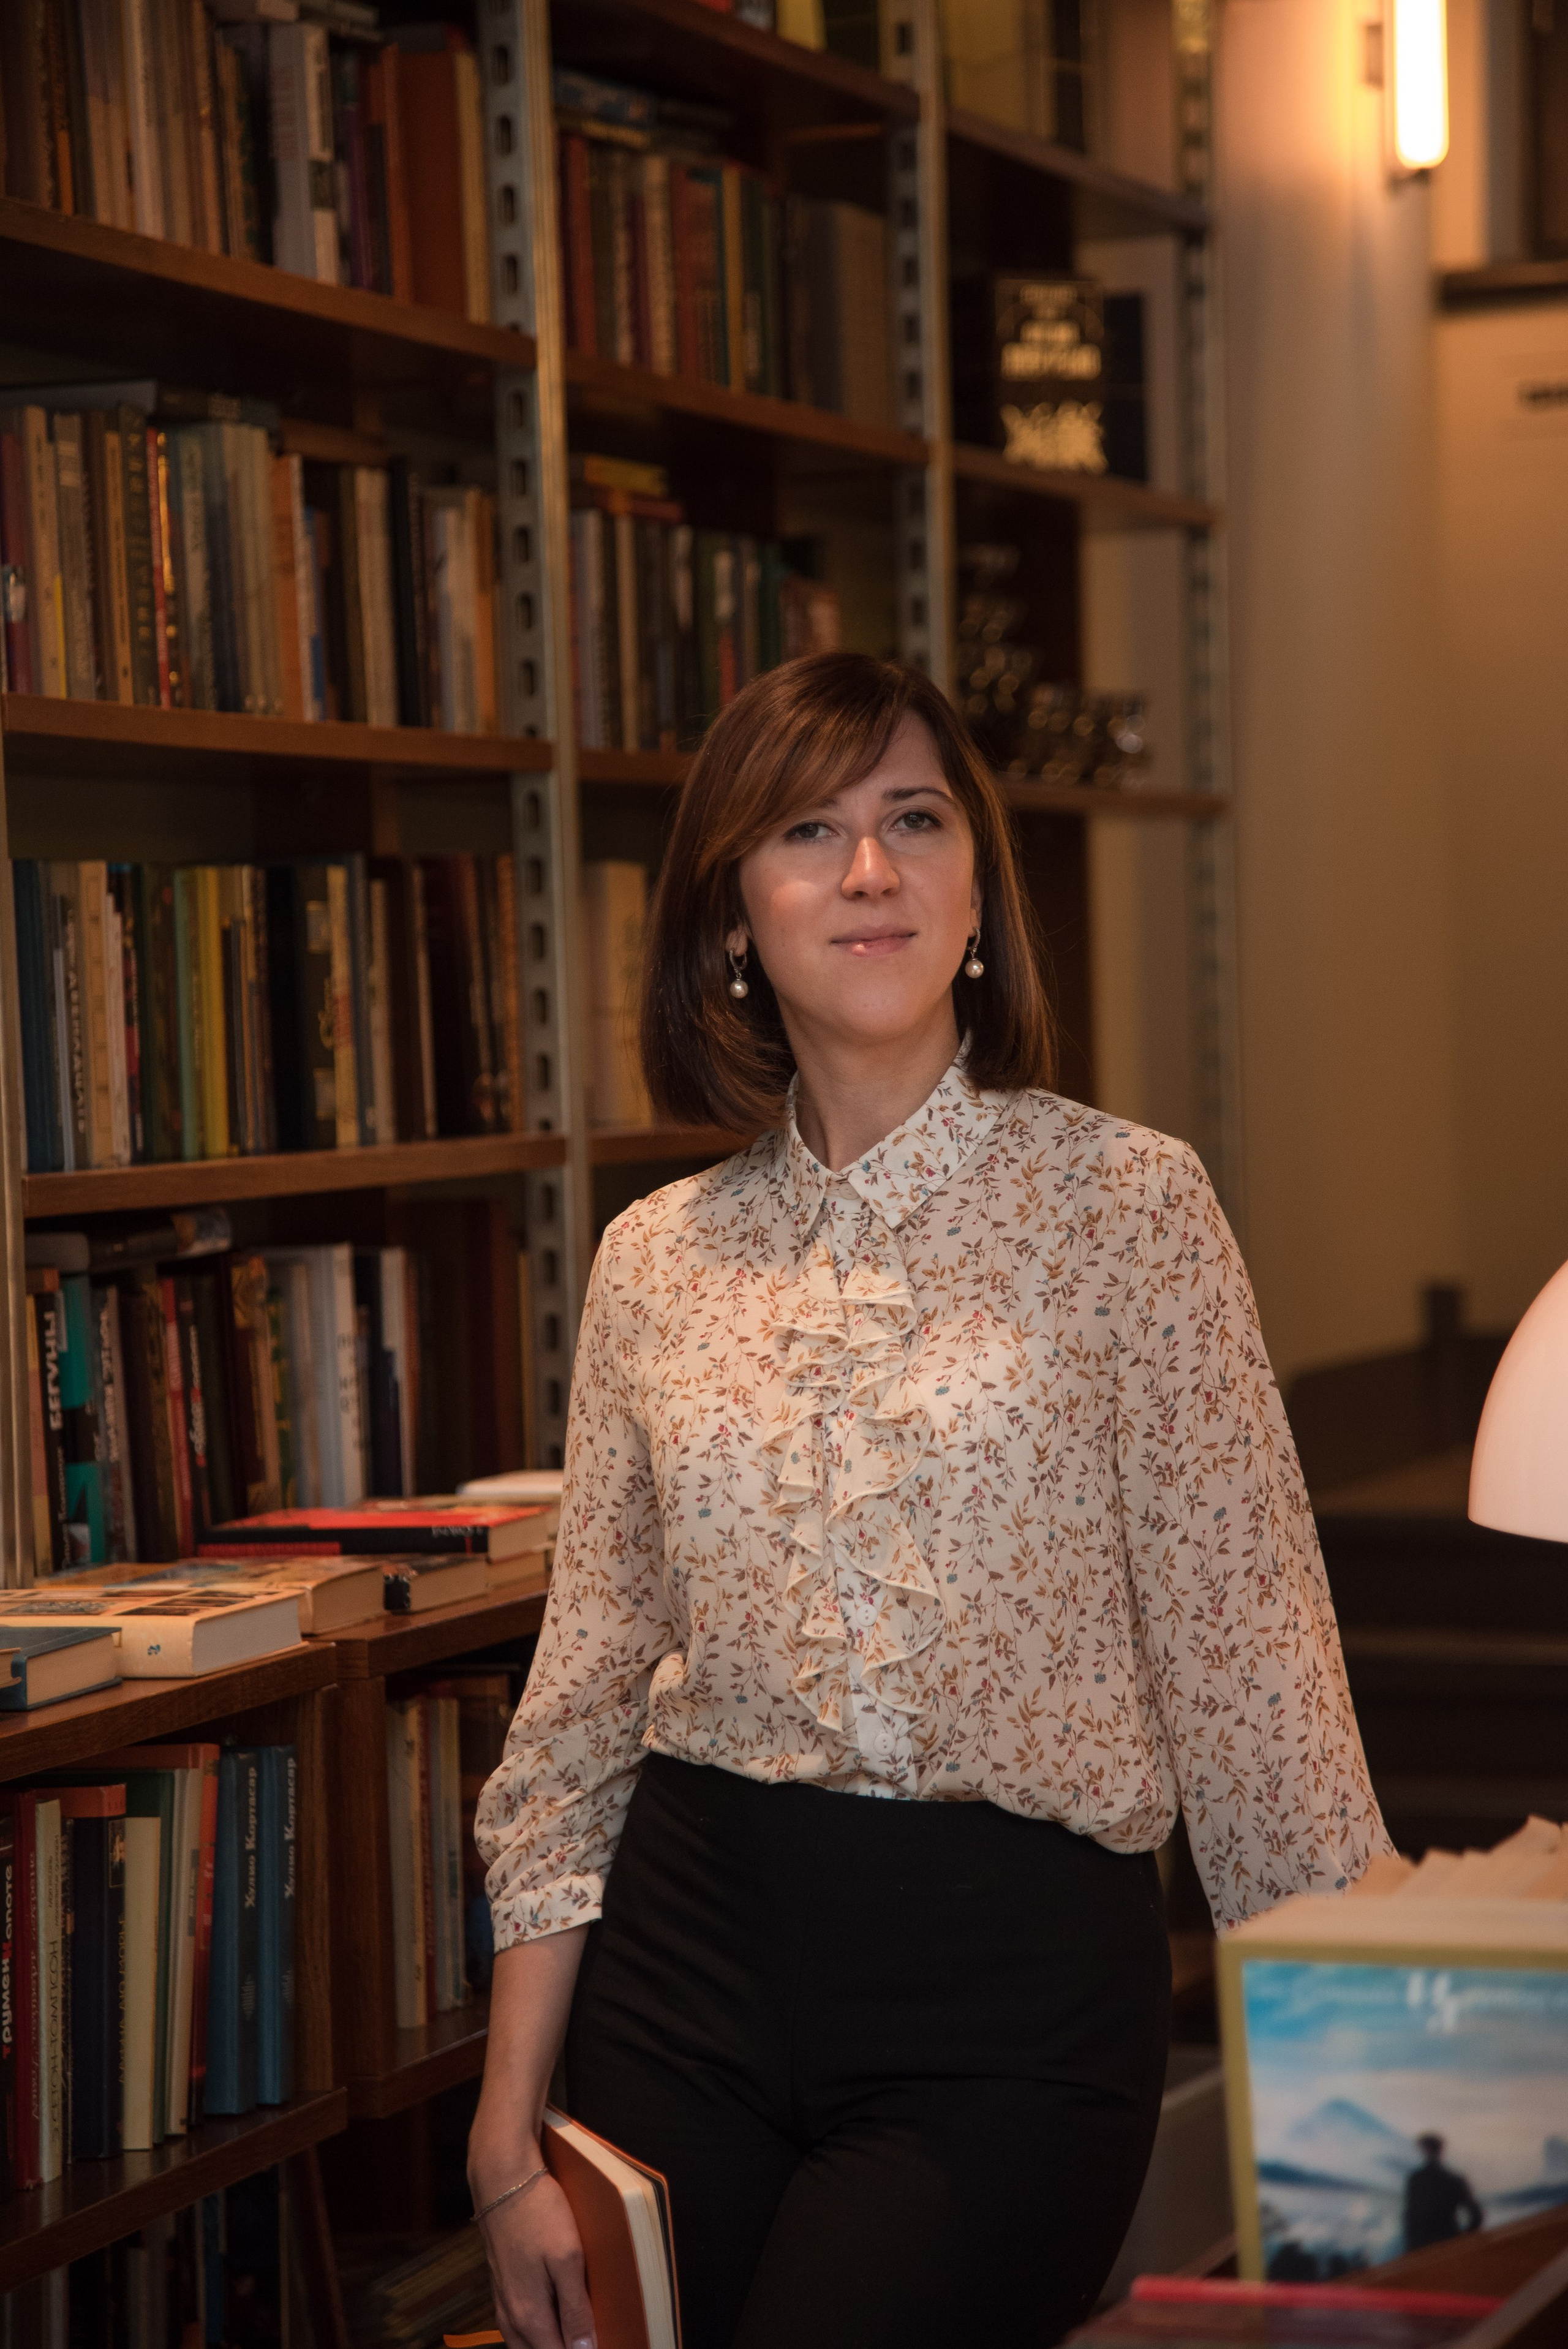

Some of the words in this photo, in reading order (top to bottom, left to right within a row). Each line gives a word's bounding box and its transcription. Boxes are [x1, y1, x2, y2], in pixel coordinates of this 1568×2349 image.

[43, 1310, 63, 1431] БЕГУНЫ
[244, 1766, 257, 1850] Кортасар
[284, 1758, 297, 1841] Кортасар
[244, 1855, 257, 1909] Хулио
[284, 1845, 295, 1898] Хулио
